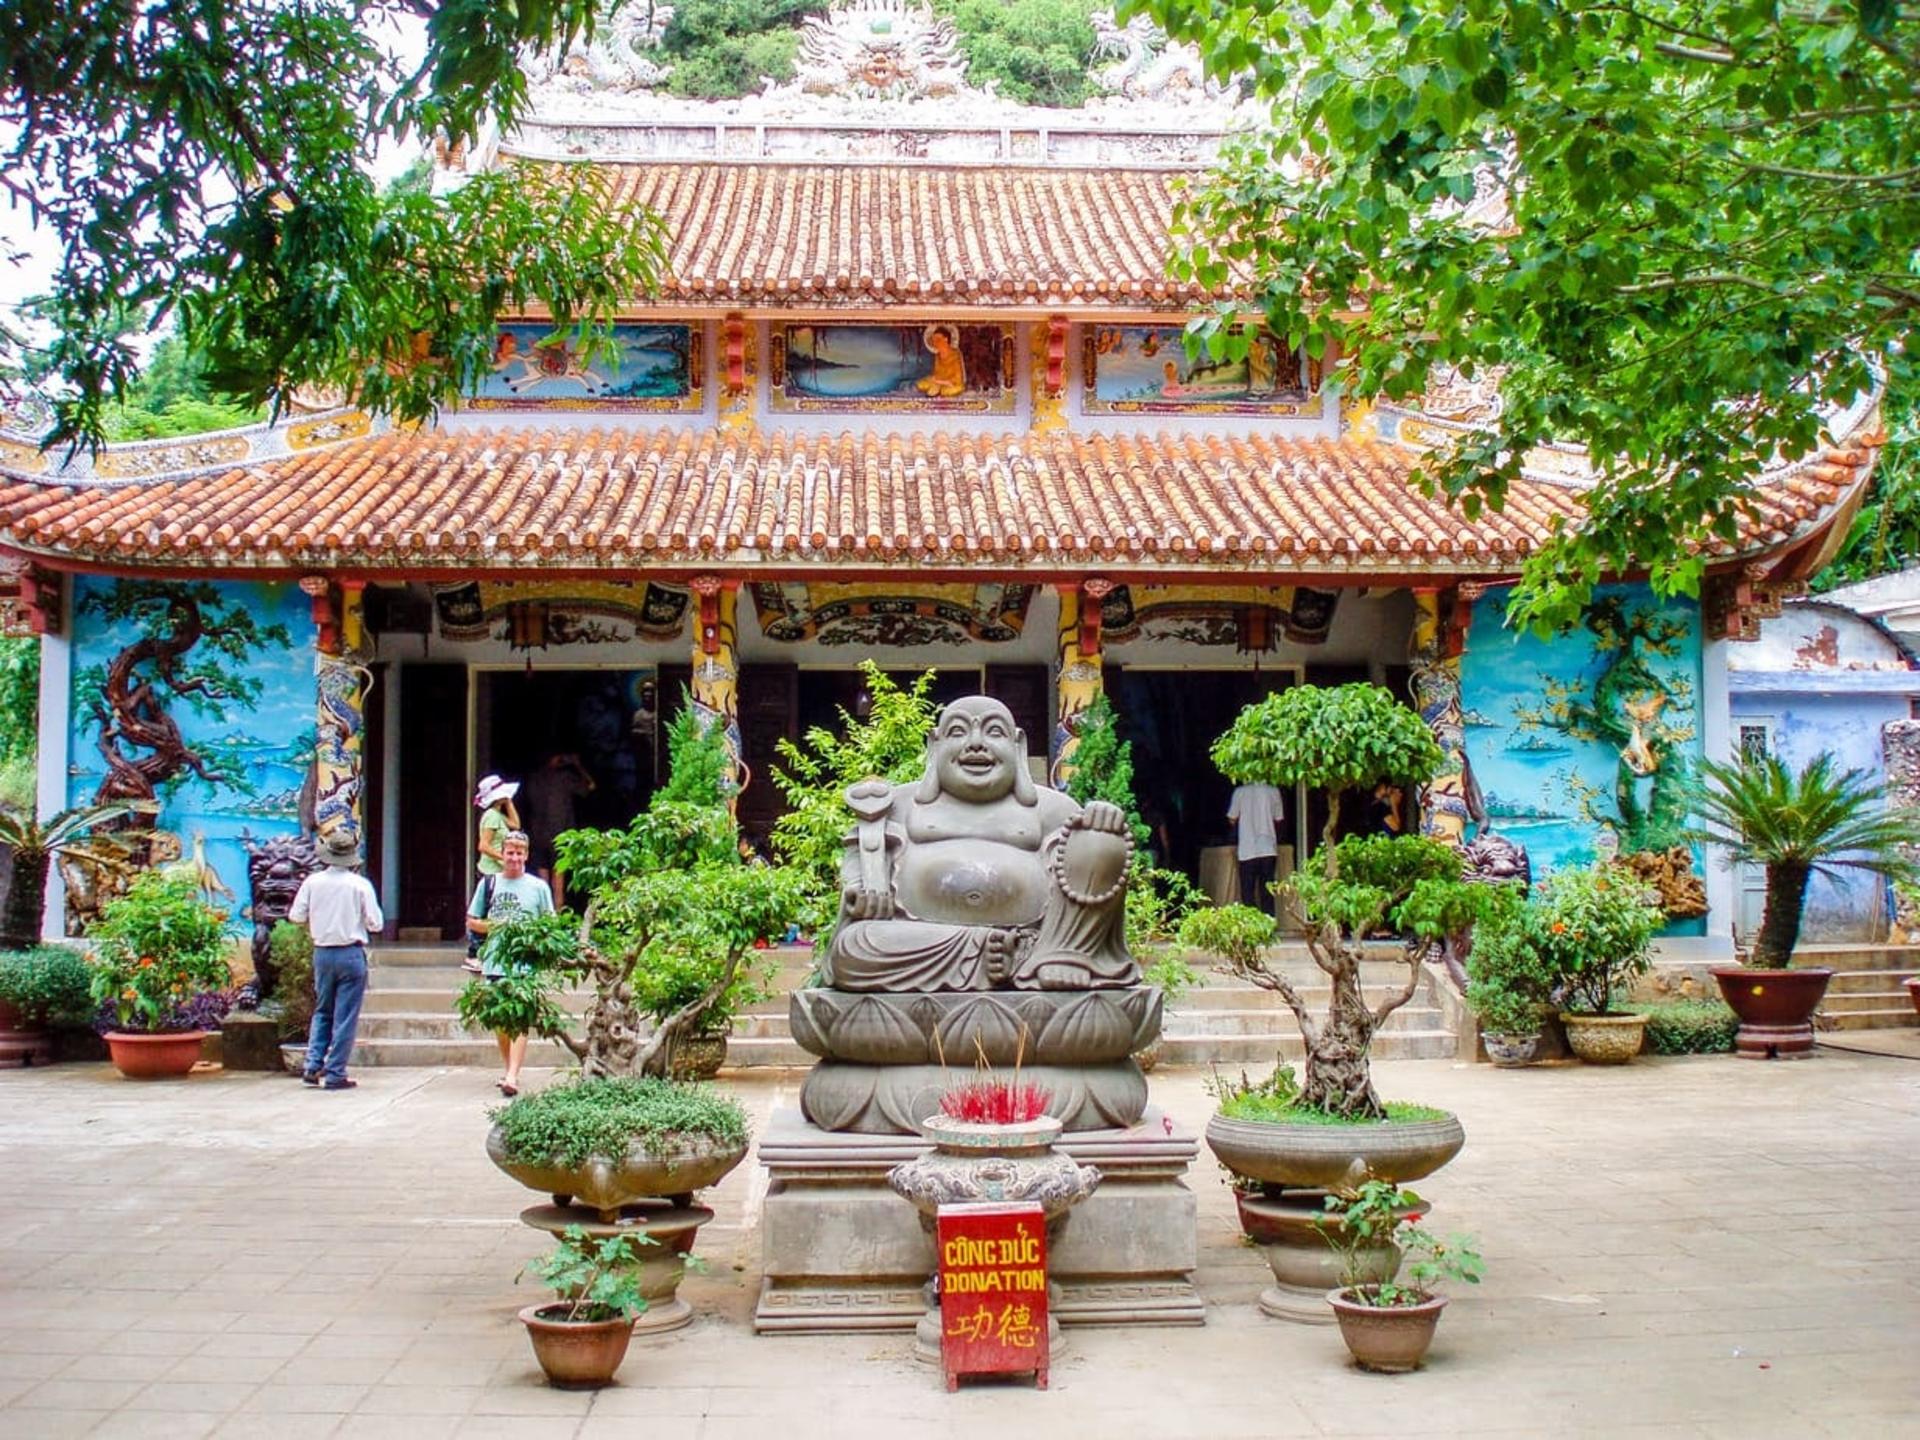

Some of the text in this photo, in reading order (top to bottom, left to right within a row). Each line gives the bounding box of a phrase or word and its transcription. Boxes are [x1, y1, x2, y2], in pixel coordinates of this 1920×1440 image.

[944, 1236, 996, 1266] CÔNG
[943, 1269, 1045, 1294] DONATION
[947, 1303, 1040, 1347] 功德
